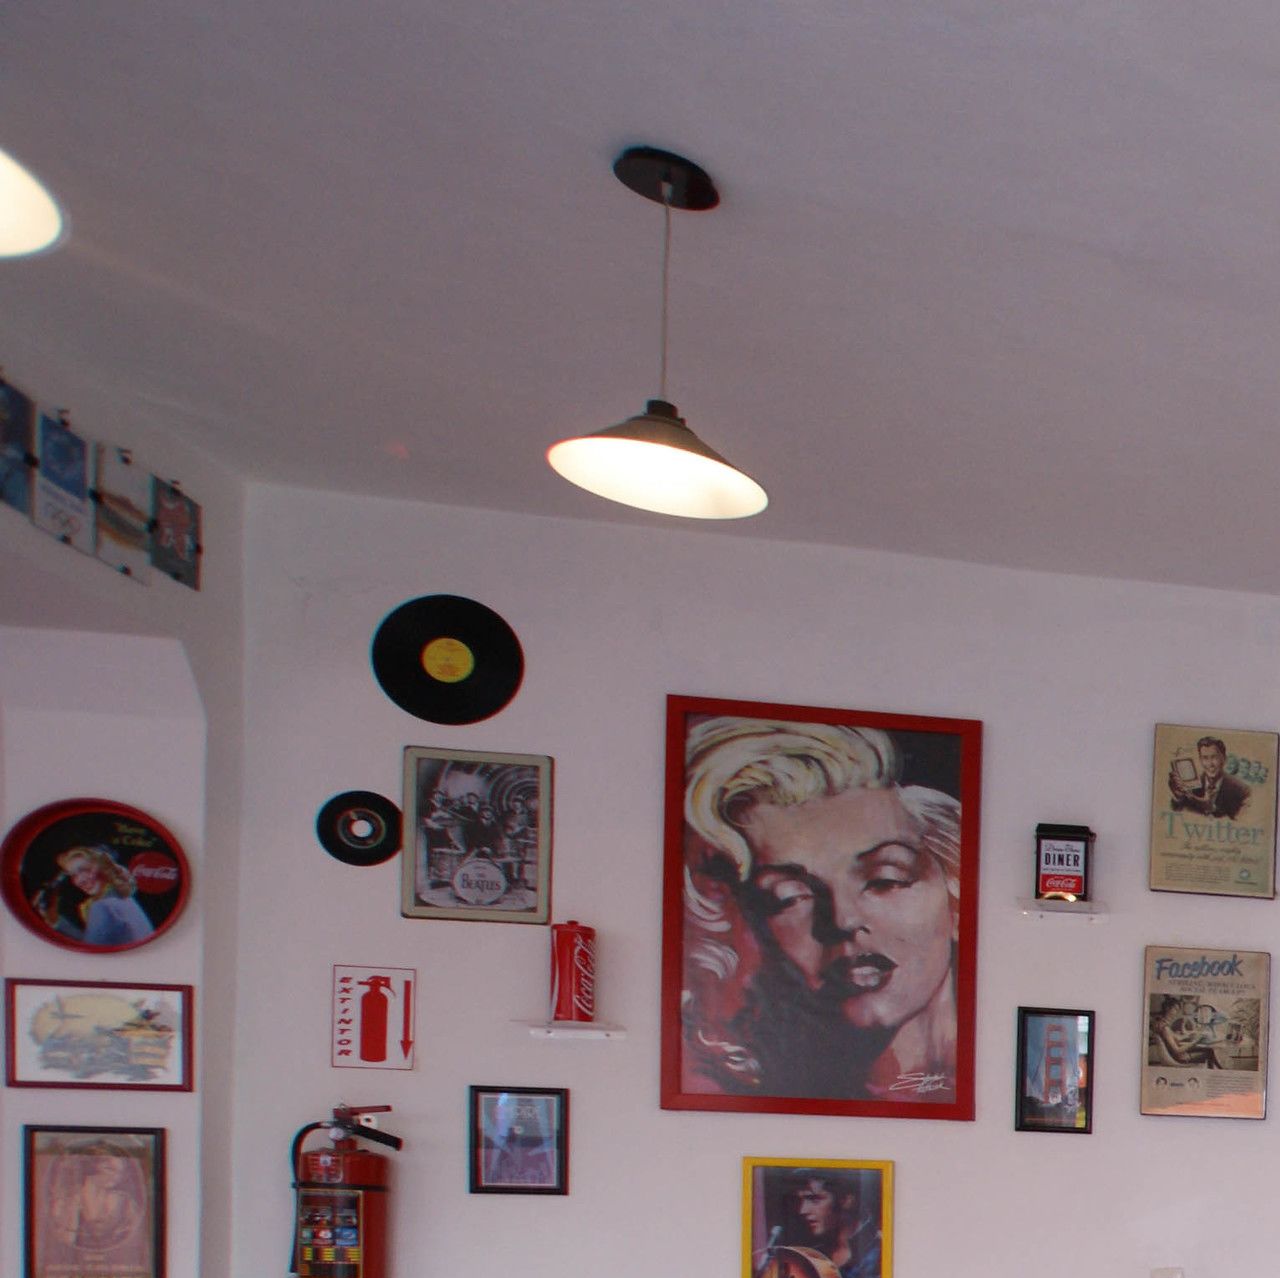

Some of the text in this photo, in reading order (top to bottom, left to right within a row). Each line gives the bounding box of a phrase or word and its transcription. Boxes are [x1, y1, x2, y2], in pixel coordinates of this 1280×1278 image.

[1158, 811, 1264, 846] Twitter
[1045, 852, 1080, 867] DINER
[1156, 954, 1244, 980] Facebook
[337, 976, 353, 1056] EXTINTOR
